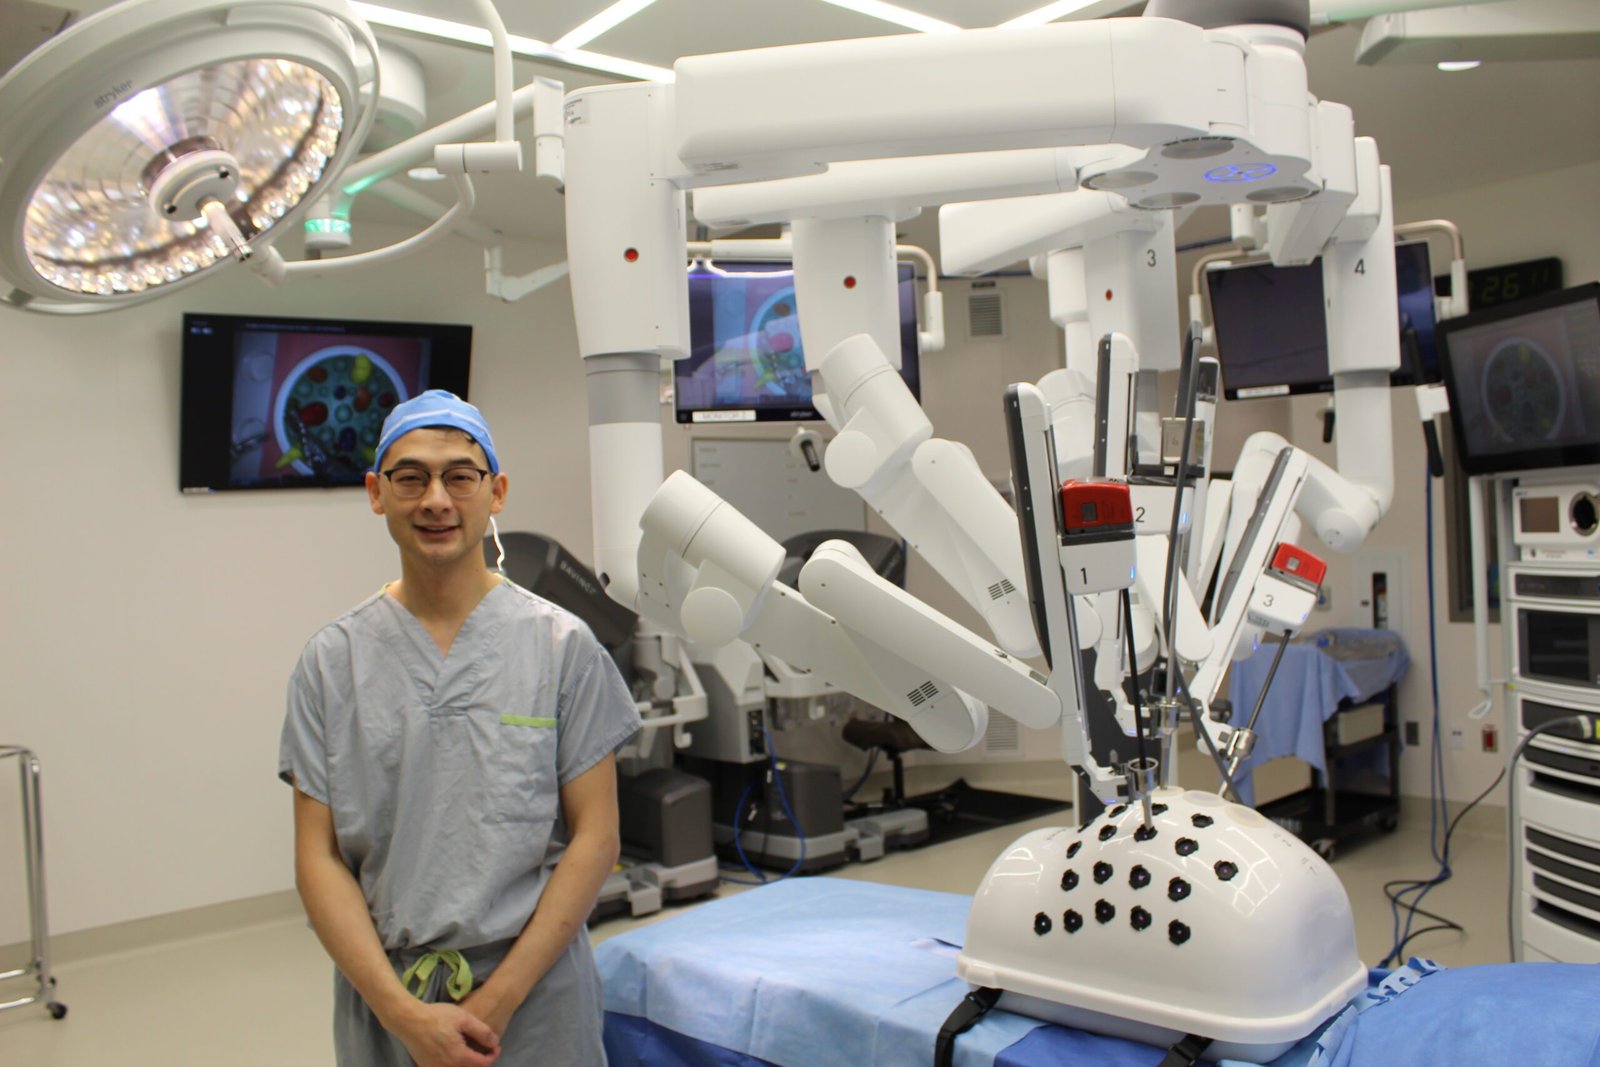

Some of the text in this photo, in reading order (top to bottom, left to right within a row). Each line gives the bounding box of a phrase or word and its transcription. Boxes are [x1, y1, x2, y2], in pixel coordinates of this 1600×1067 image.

[94, 79, 133, 109] stryker
[1147, 248, 1157, 268] 3
[1354, 258, 1366, 276] 4
[1135, 506, 1146, 523] 2
[1080, 567, 1088, 585] 1
[1262, 594, 1274, 607] 3
